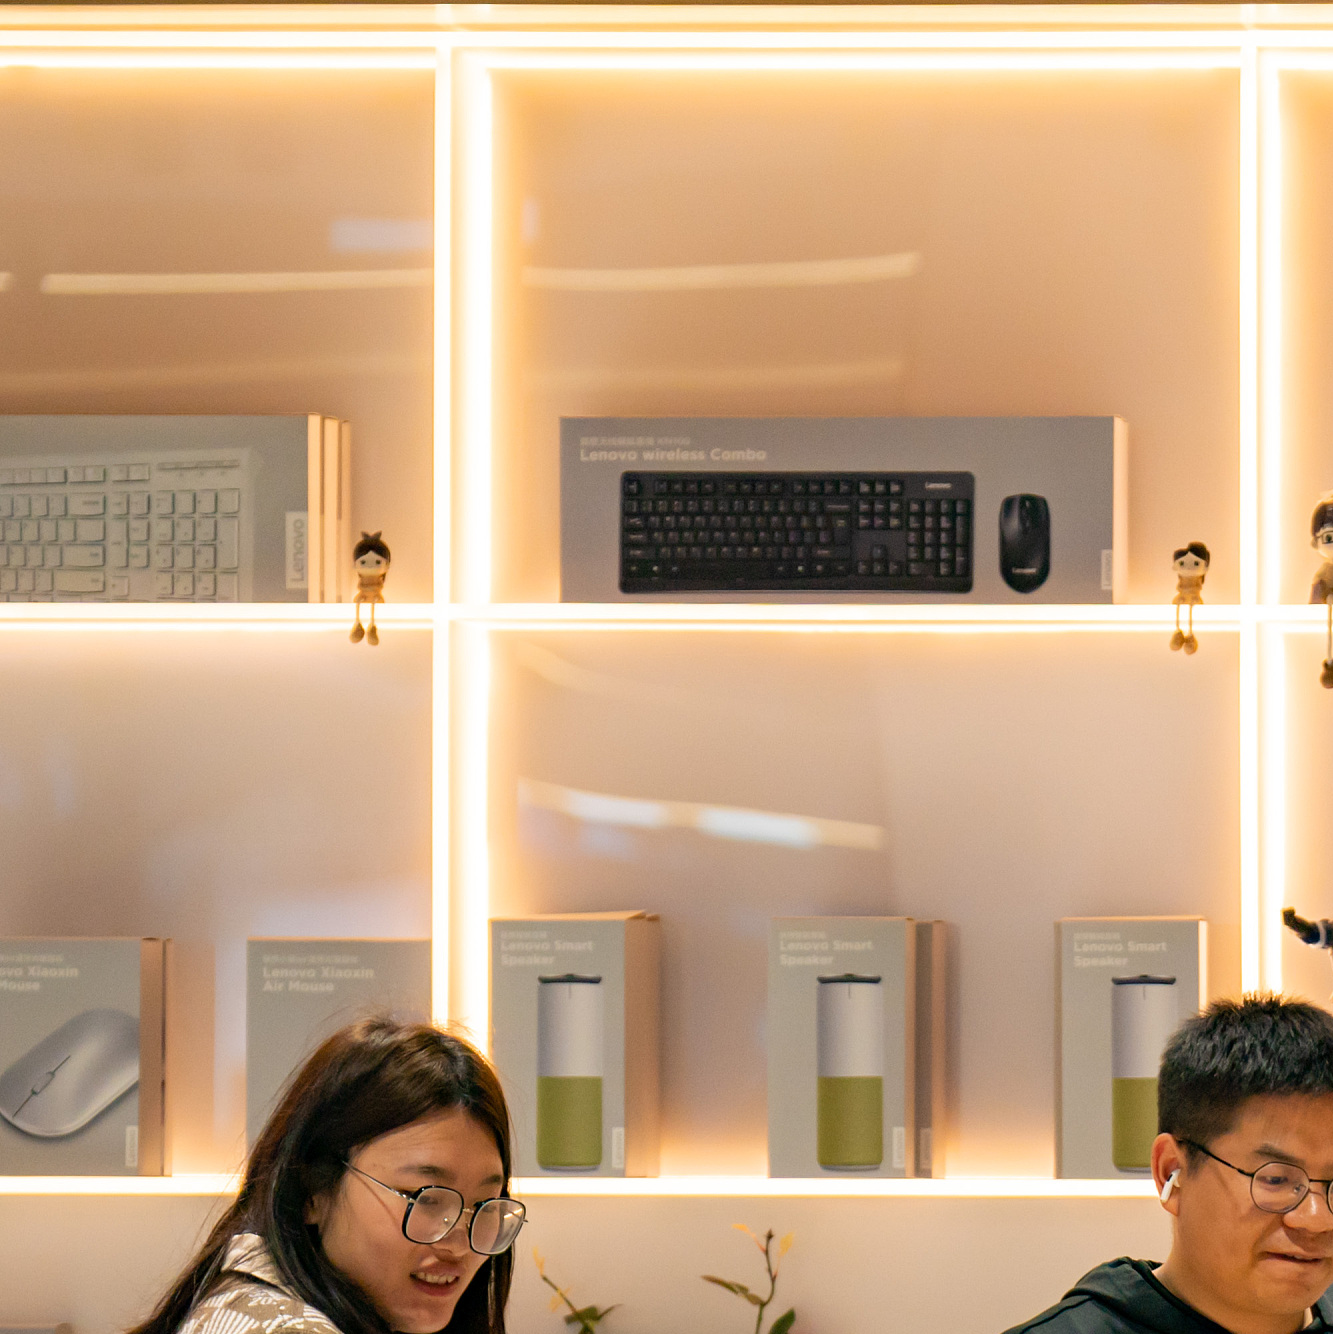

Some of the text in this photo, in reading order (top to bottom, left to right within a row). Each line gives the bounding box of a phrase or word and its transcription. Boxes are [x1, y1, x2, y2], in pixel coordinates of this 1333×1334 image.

[580, 448, 767, 461] Lenovo wireless Combo
[292, 518, 305, 582] Lenovo
[1073, 940, 1167, 952] Lenovo Smart
[262, 966, 375, 978] Lenovo Xiaoxin
[262, 980, 334, 992] Air Mouse
